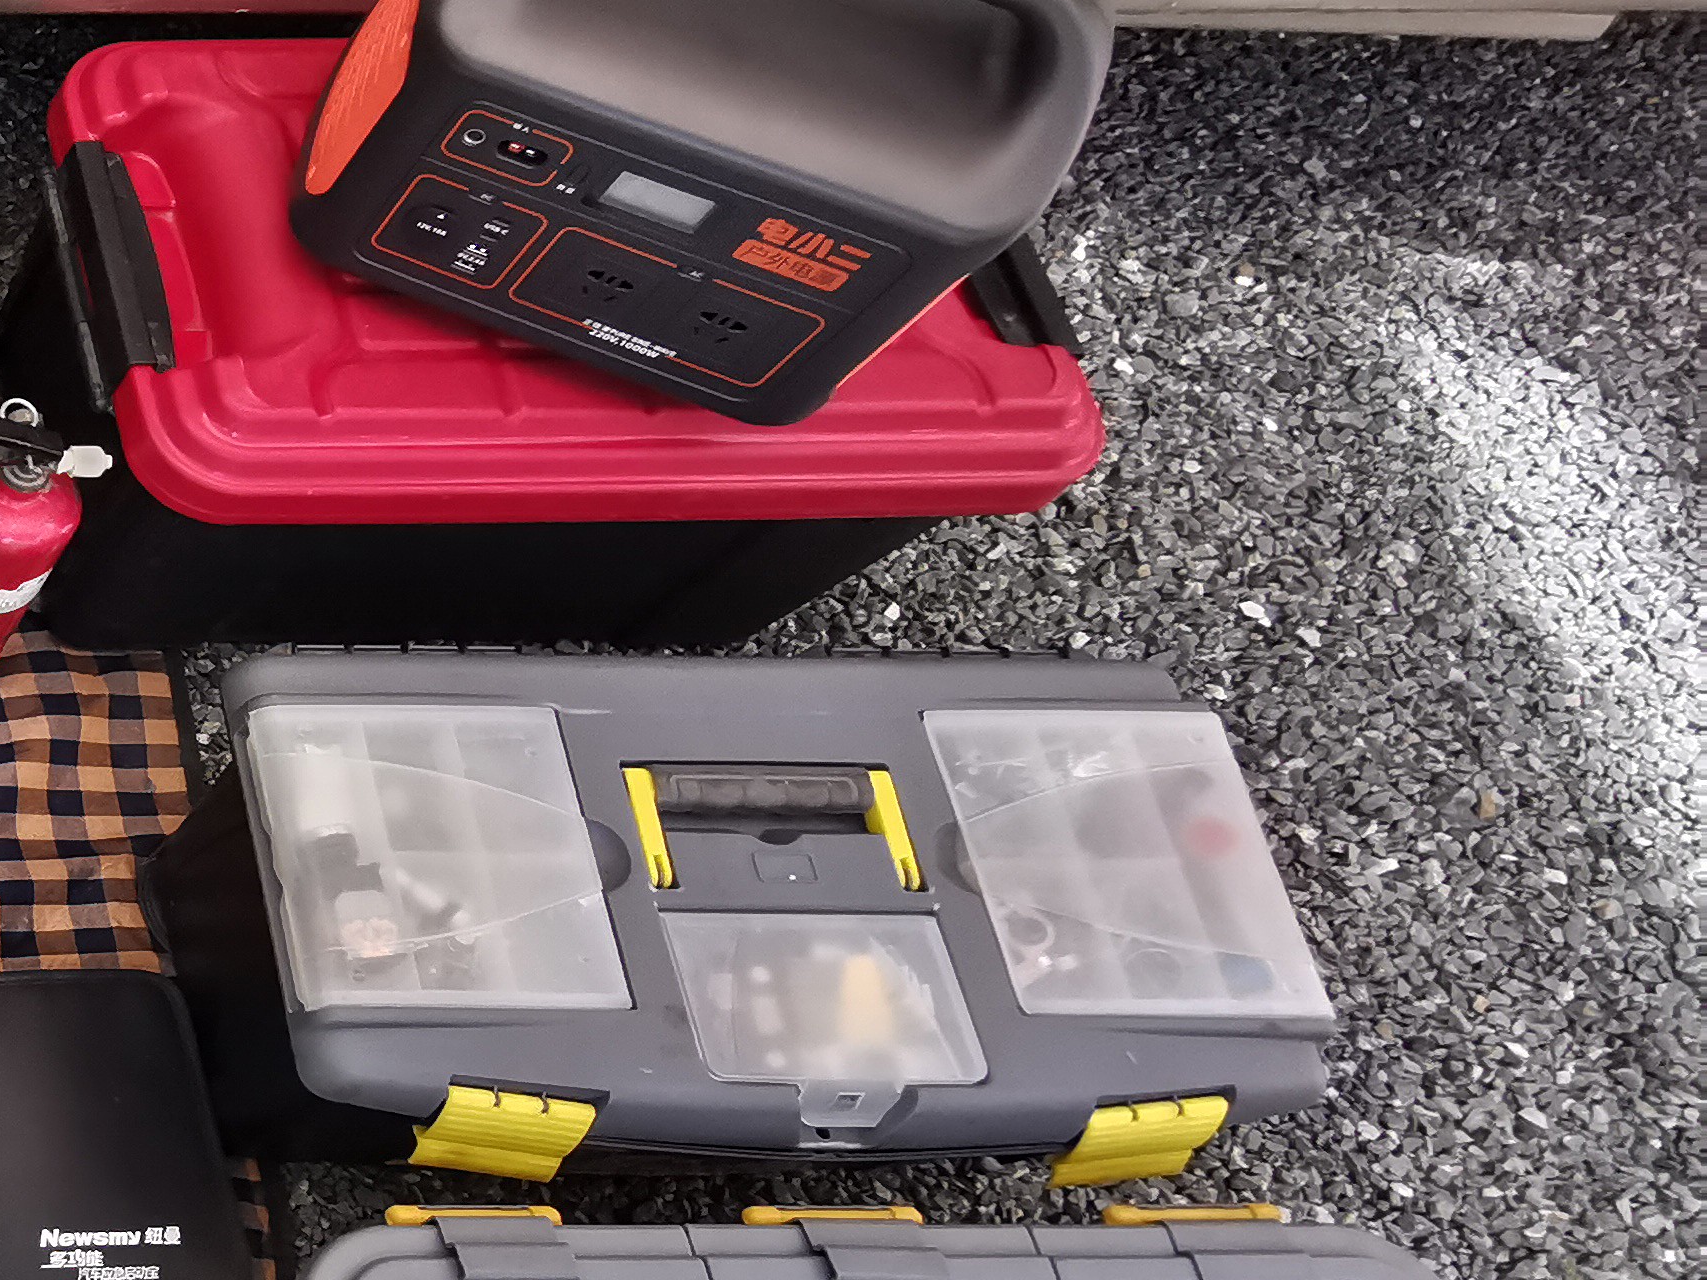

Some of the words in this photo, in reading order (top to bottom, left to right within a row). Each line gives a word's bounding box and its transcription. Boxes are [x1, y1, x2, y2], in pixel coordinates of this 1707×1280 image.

[756, 217, 874, 271] 电小二
[588, 328, 661, 360] 220V,1000W
[39, 1227, 142, 1249] Newsmy
[144, 1226, 182, 1246] 纽曼
[49, 1248, 105, 1268] 多功能
